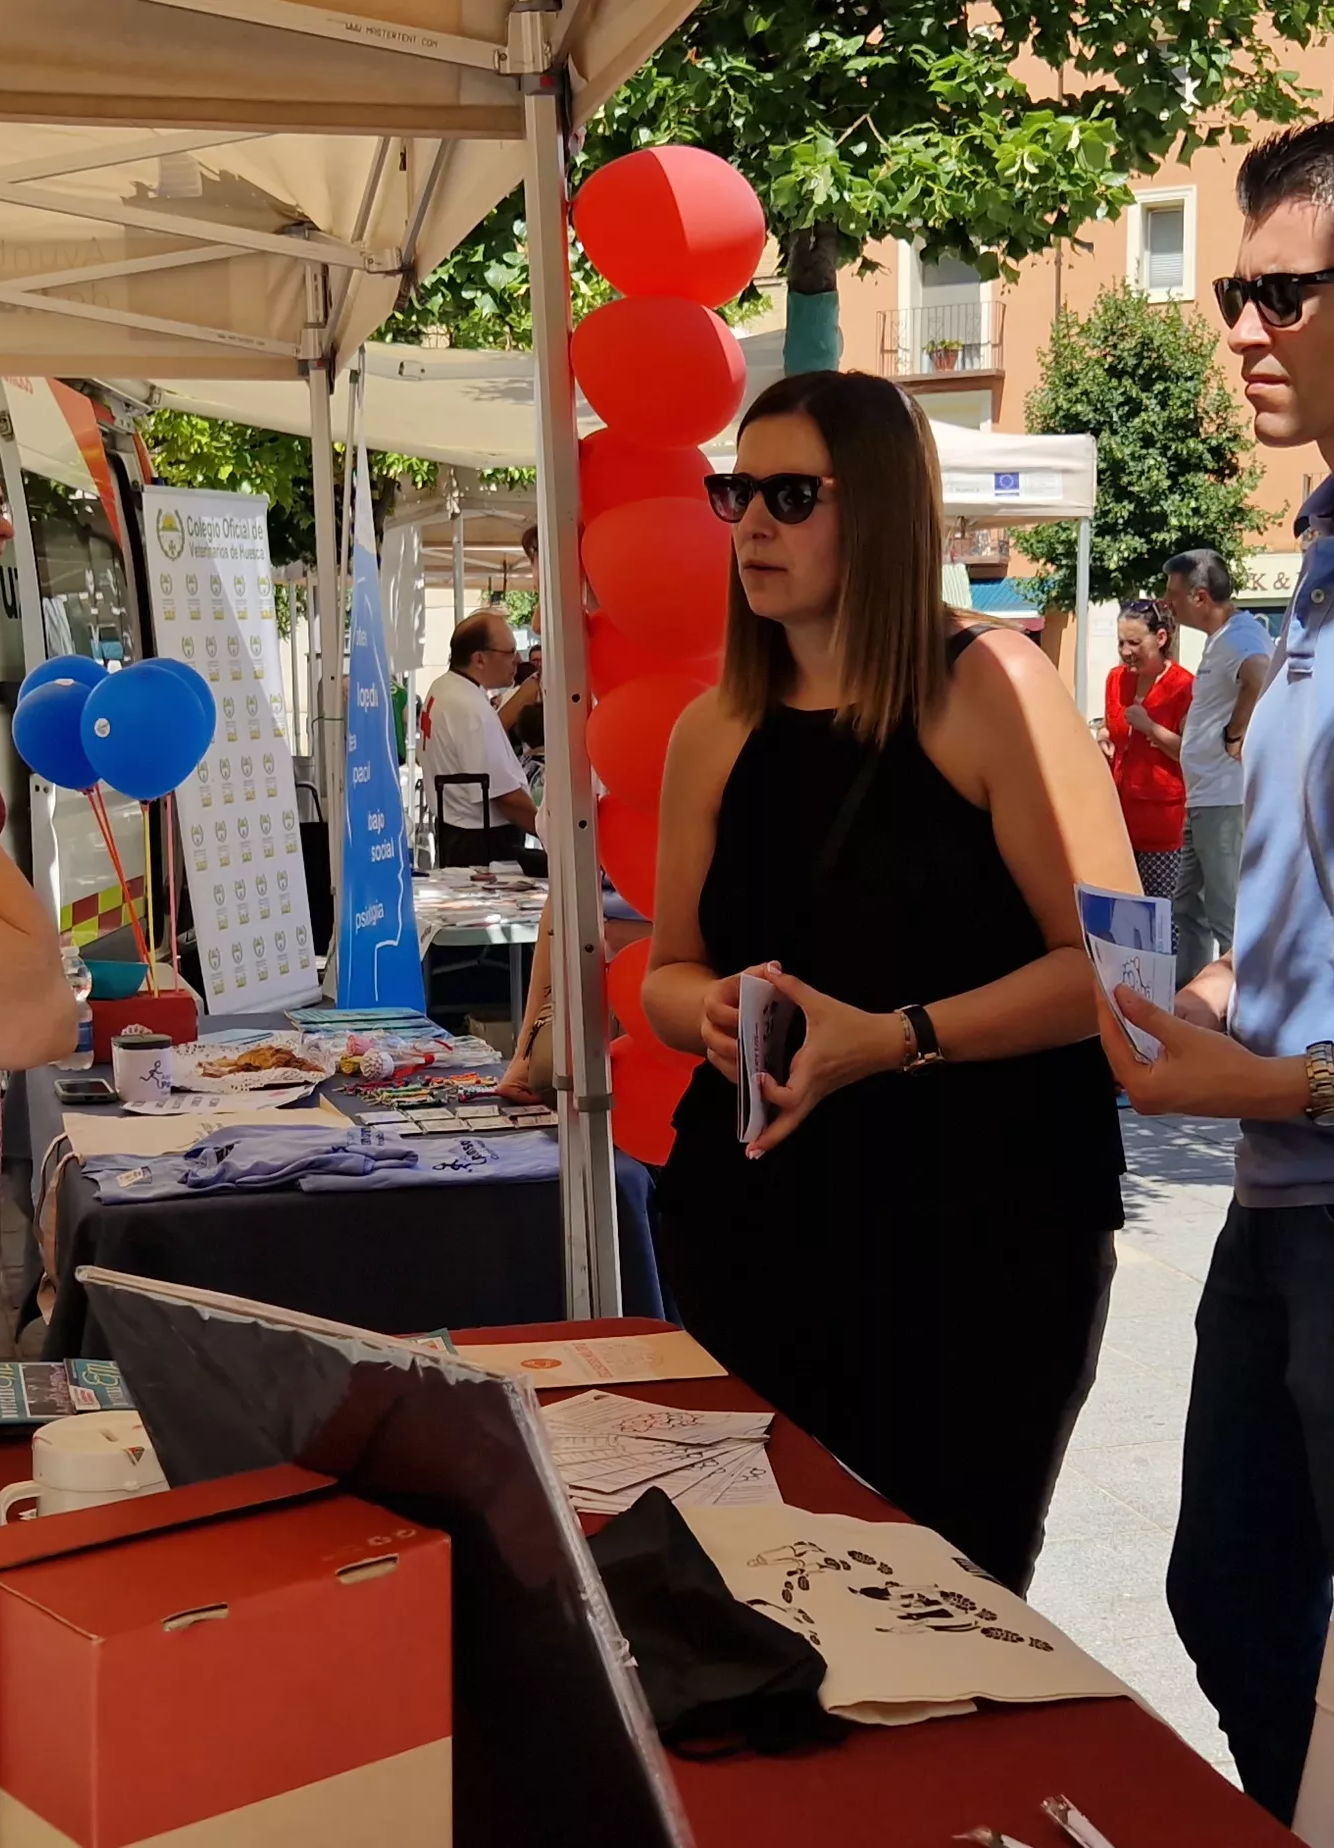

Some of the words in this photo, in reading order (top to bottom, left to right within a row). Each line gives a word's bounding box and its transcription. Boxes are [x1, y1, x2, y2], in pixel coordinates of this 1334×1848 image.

[187, 515, 221, 543] Colegio
[222, 517, 250, 540] Oficial
[251, 520, 264, 541] de
[188, 542, 229, 560] Veterinarios
[230, 543, 239, 560] de
[240, 544, 265, 560] Huesca
[1273, 571, 1291, 590] &
[371, 837, 395, 863] social
